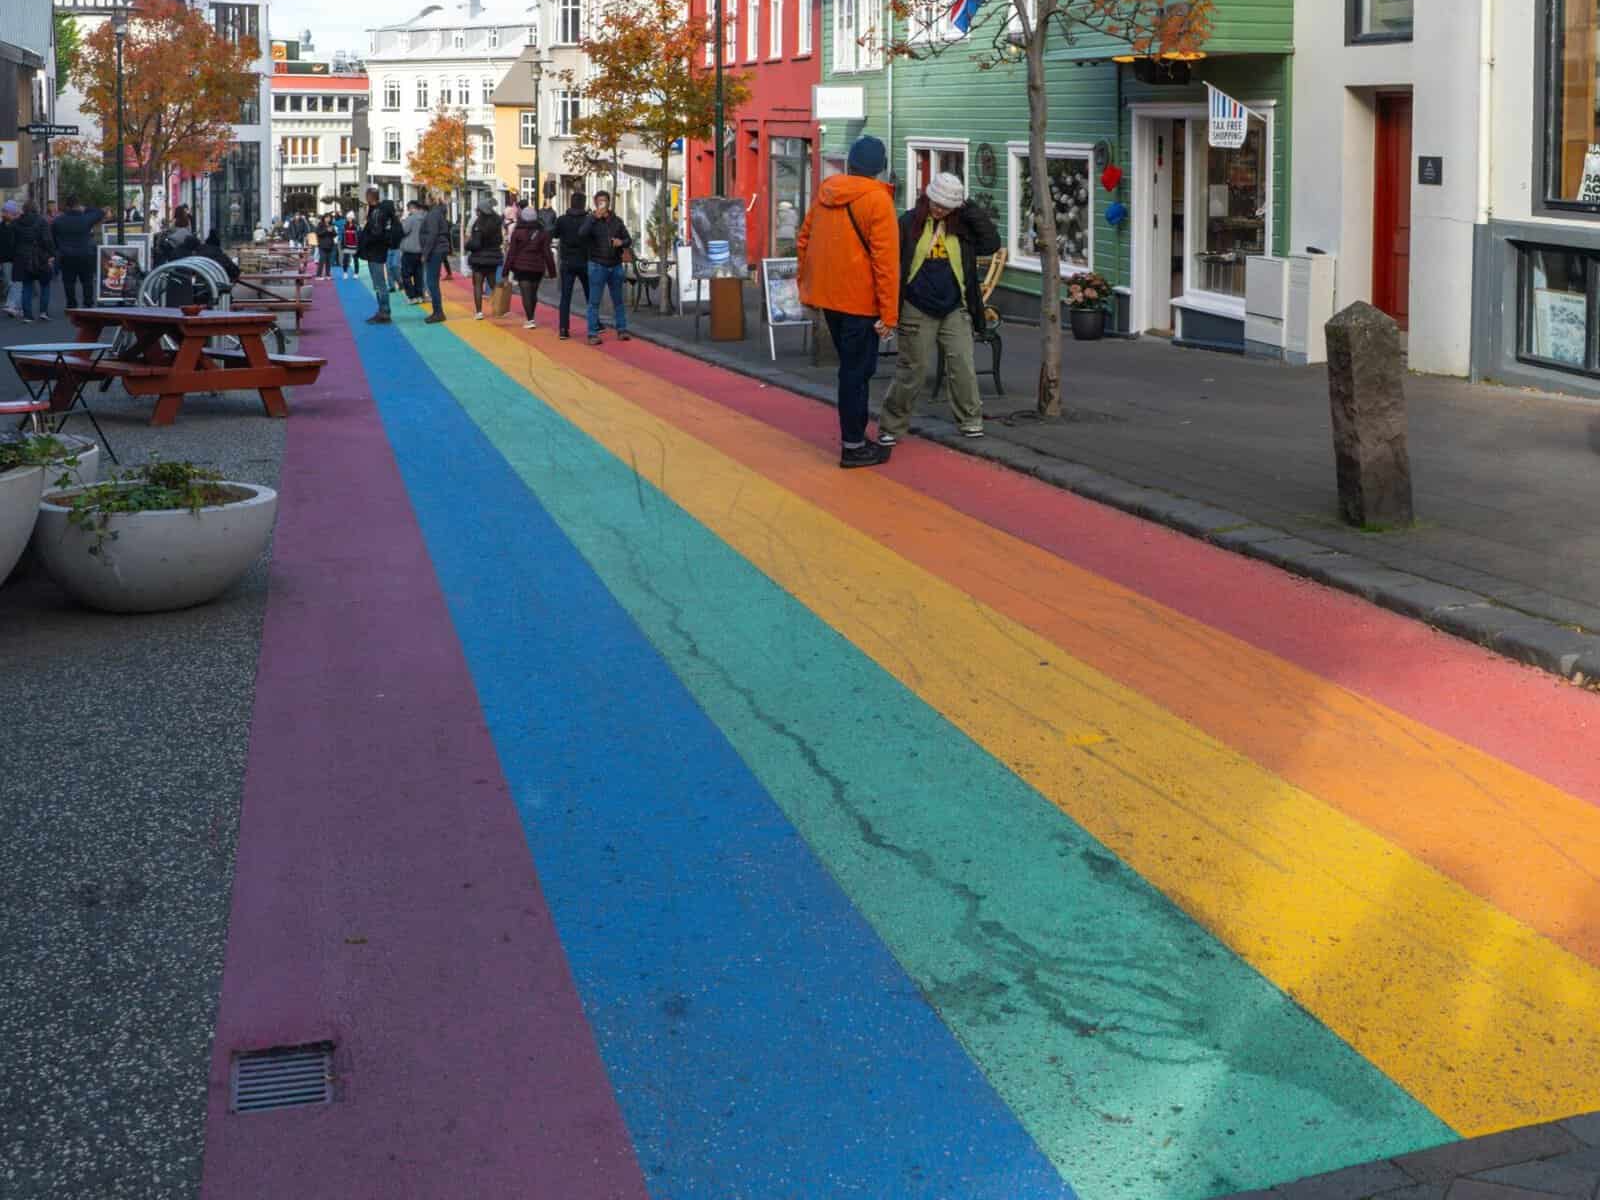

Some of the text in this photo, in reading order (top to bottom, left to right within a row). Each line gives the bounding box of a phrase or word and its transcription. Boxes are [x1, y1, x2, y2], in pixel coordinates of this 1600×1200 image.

[1212, 120, 1243, 131] TAX FREE
[1212, 131, 1244, 141] SHOPPING
